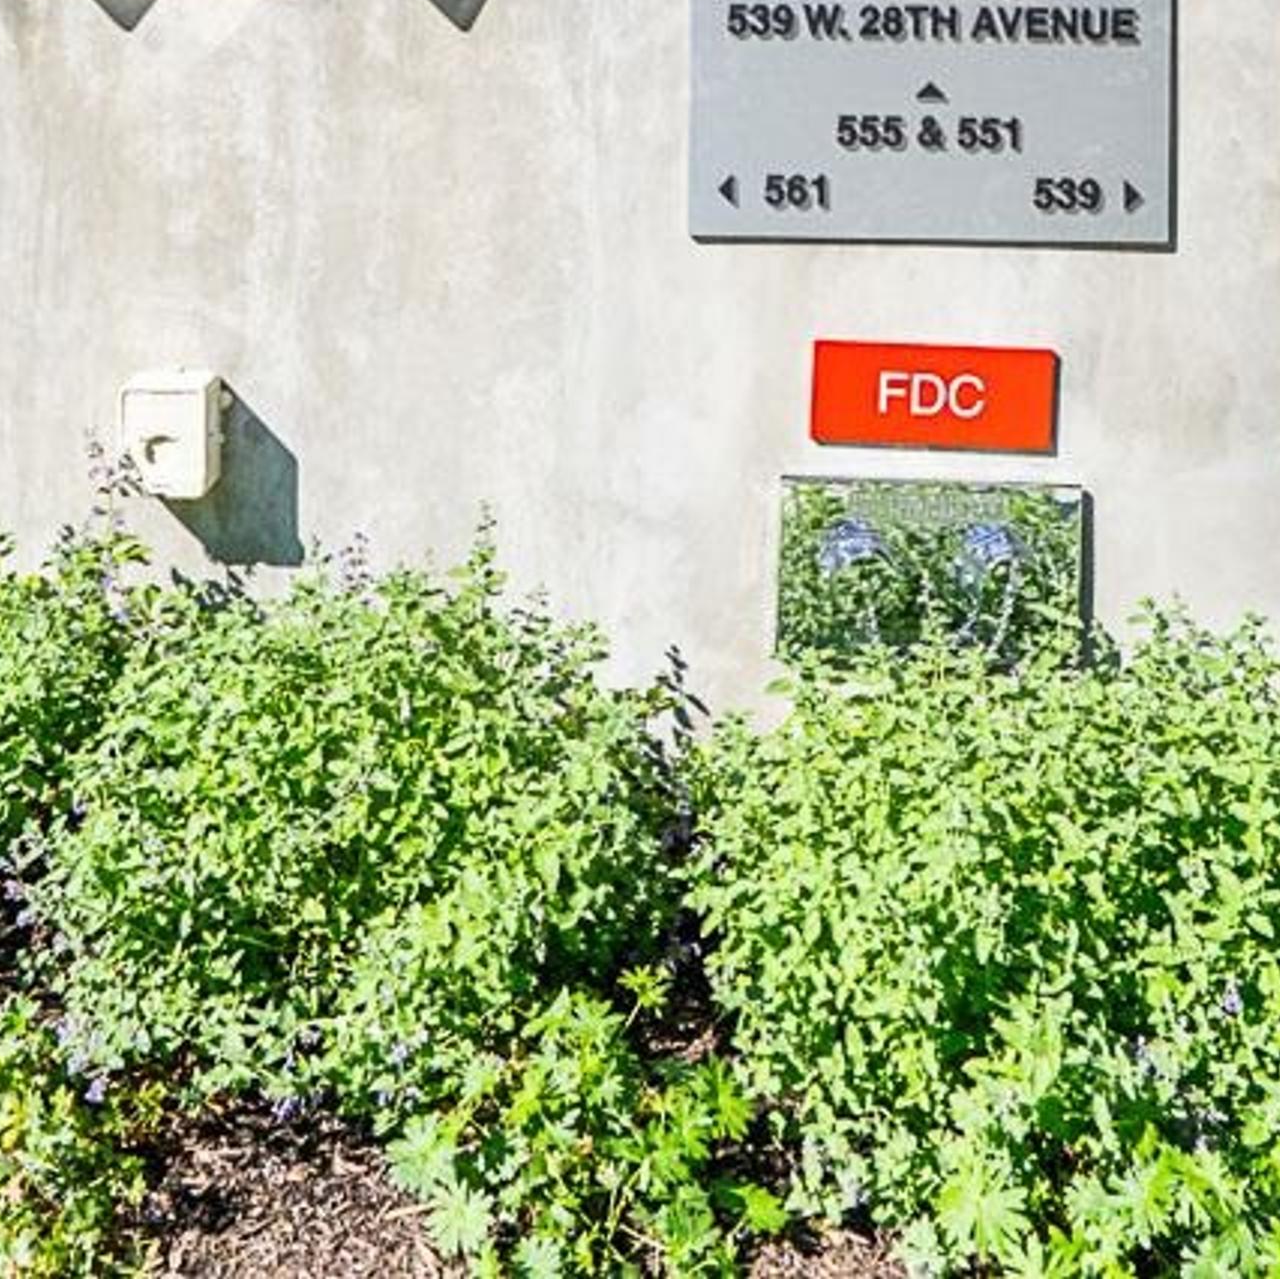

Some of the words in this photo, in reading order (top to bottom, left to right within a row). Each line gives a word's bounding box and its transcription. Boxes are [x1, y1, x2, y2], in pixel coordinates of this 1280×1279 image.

[727, 3, 795, 36] 539
[803, 3, 848, 38] W.
[859, 5, 957, 39] 28TH
[971, 7, 1138, 41] AVENUE
[837, 116, 904, 148] 555
[917, 116, 945, 149] &
[958, 117, 1022, 150] 551
[765, 174, 829, 207] 561
[1033, 178, 1102, 210] 539
[878, 371, 985, 419] FDC
